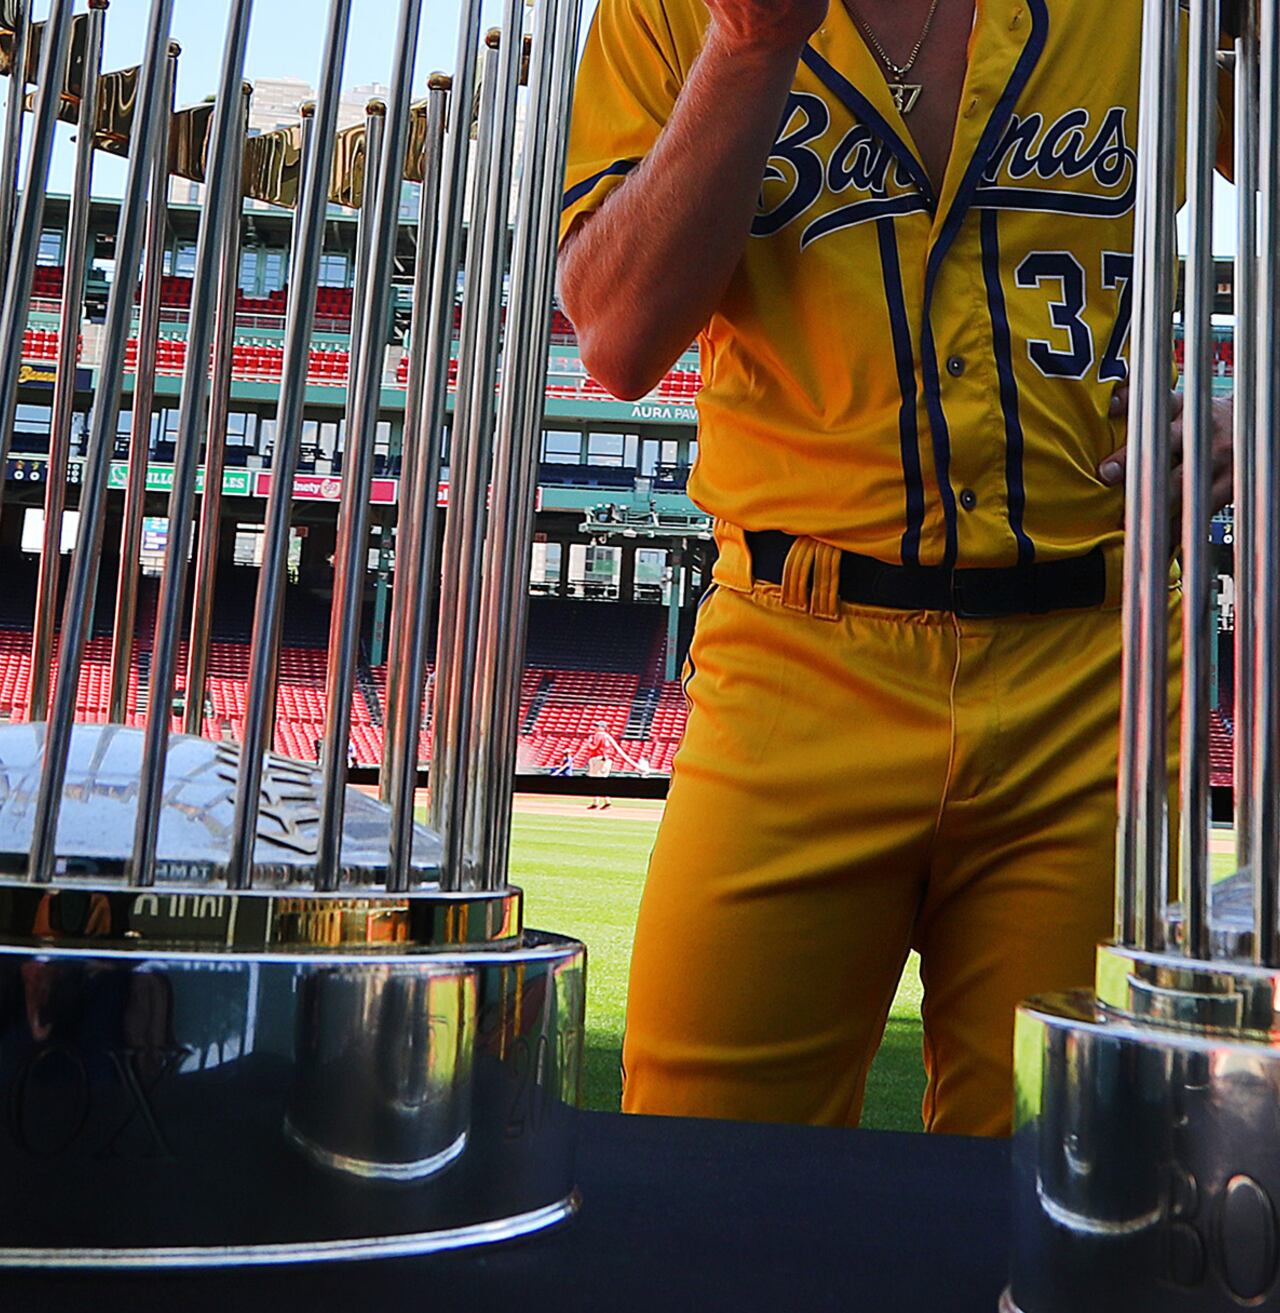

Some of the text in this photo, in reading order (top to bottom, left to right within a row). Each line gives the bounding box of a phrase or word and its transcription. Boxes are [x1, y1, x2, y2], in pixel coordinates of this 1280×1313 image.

[888, 84, 922, 113] 37
[750, 90, 1139, 242] Bannas
[1014, 250, 1134, 383] 37
